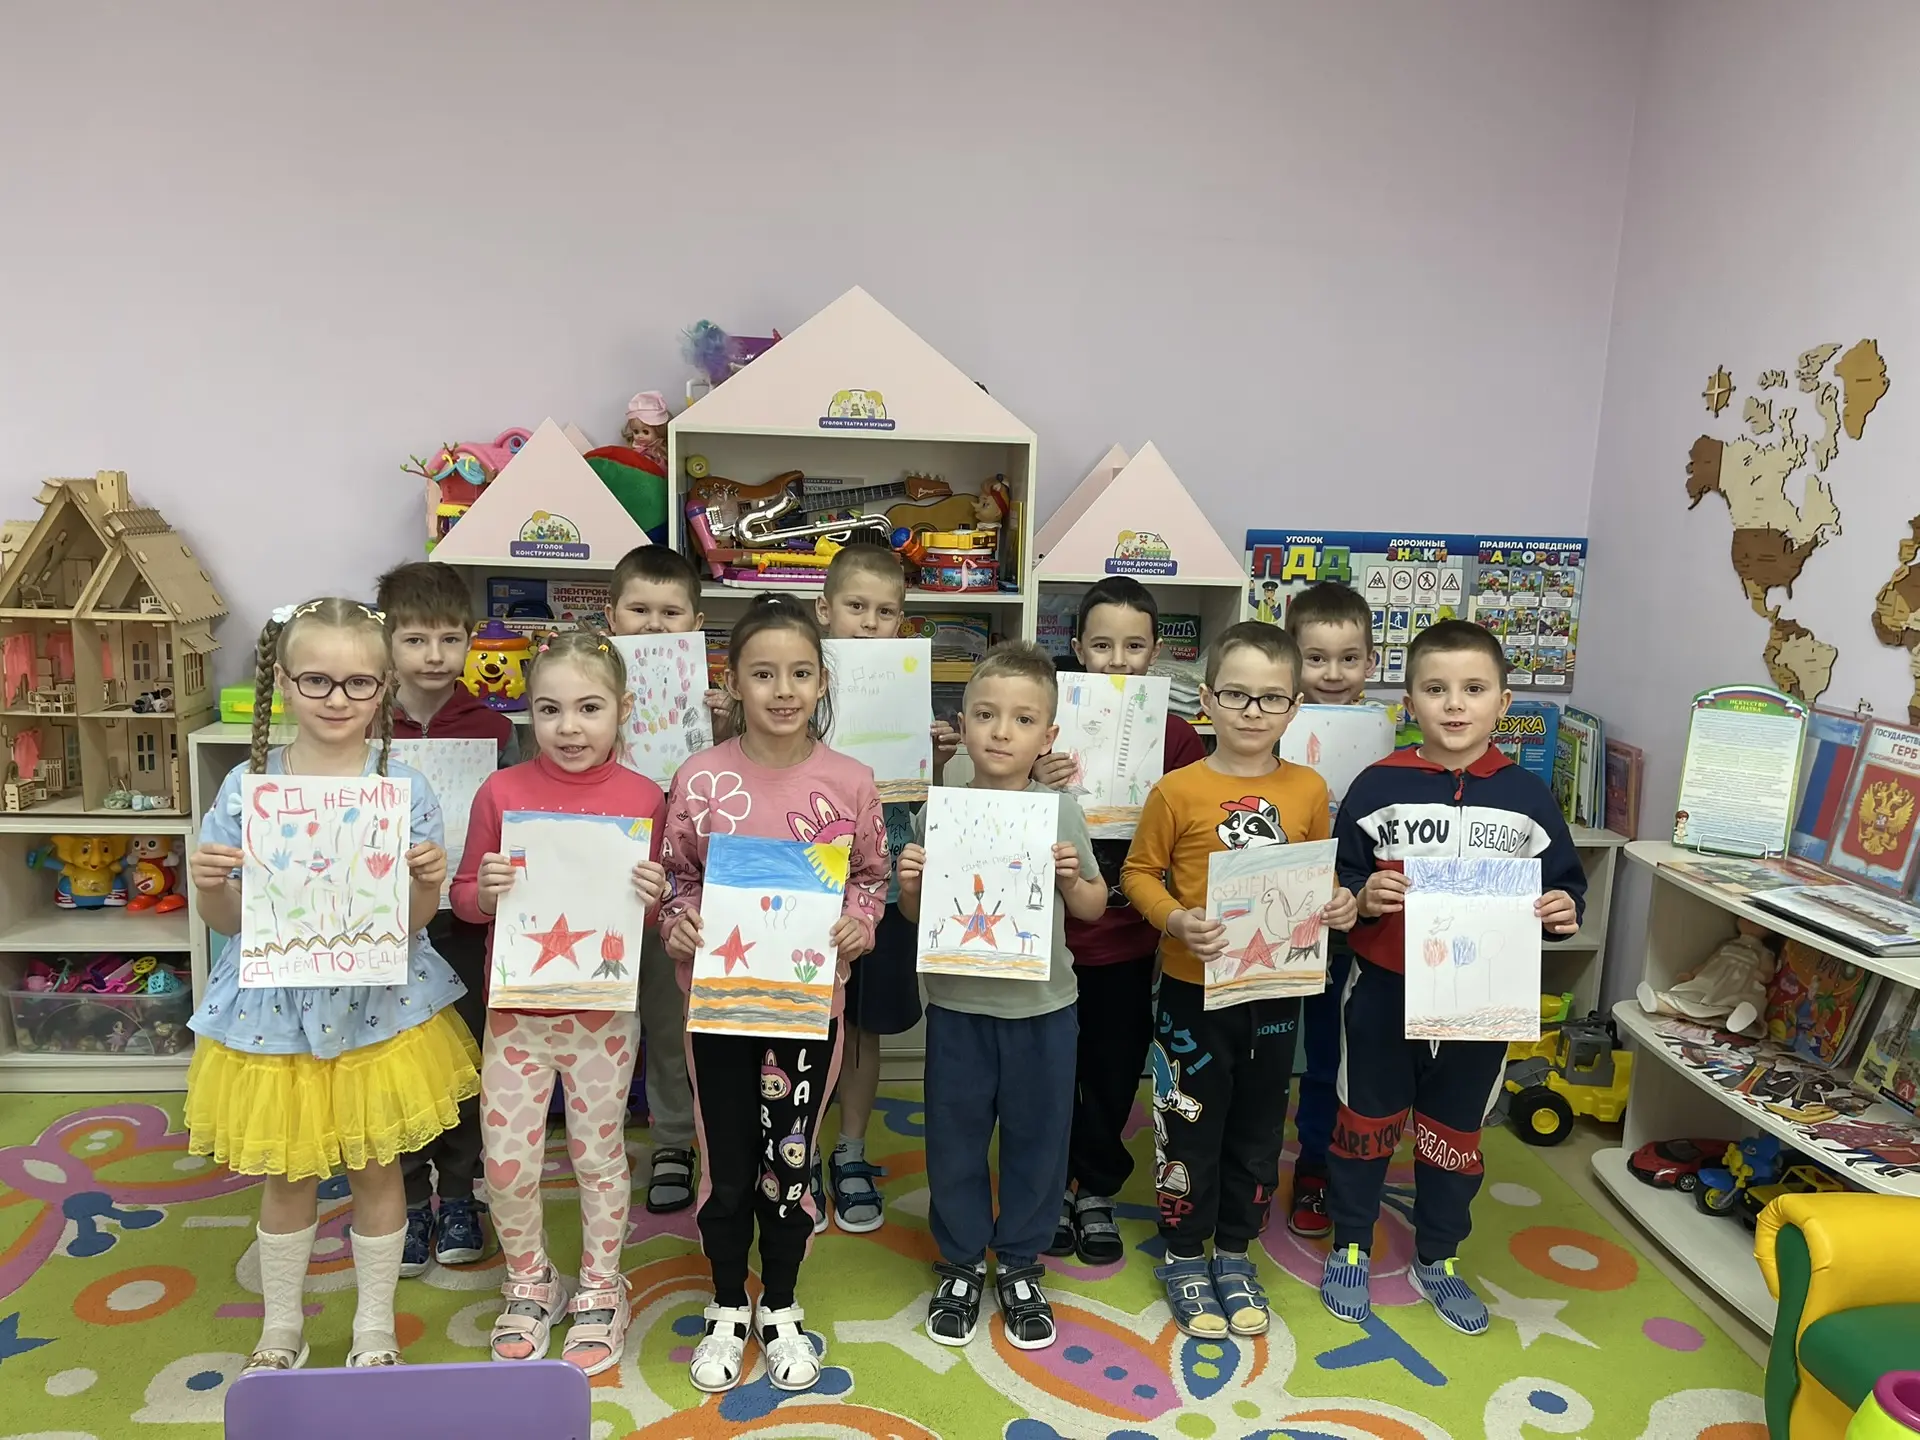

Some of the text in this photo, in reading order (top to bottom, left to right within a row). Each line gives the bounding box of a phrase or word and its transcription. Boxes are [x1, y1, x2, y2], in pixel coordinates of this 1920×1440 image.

[1286, 536, 1324, 544] УГОЛОК
[1389, 538, 1446, 548] ДОРОЖНЫЕ
[1479, 541, 1582, 551] ПРАВИЛА ПОВЕДЕНИЯ
[515, 549, 584, 558] КОНСТРУИРОВАНИЯ
[1386, 547, 1448, 562] ЗНАКИ
[1478, 550, 1580, 567] НА ДОРОГЕ
[1116, 566, 1166, 574] БЕЗОПАСНОСТИ
[1135, 560, 1173, 568] ДОРОЖНОЙ
[1253, 544, 1352, 584] ПДД
[1157, 620, 1197, 638] РИНА
[1492, 715, 1546, 736] БУКА
[1890, 743, 1919, 760] ГЕРБ
[1404, 818, 1450, 845] YOU
[1337, 1121, 1370, 1157] ARE
[1372, 1117, 1405, 1154] YOU
